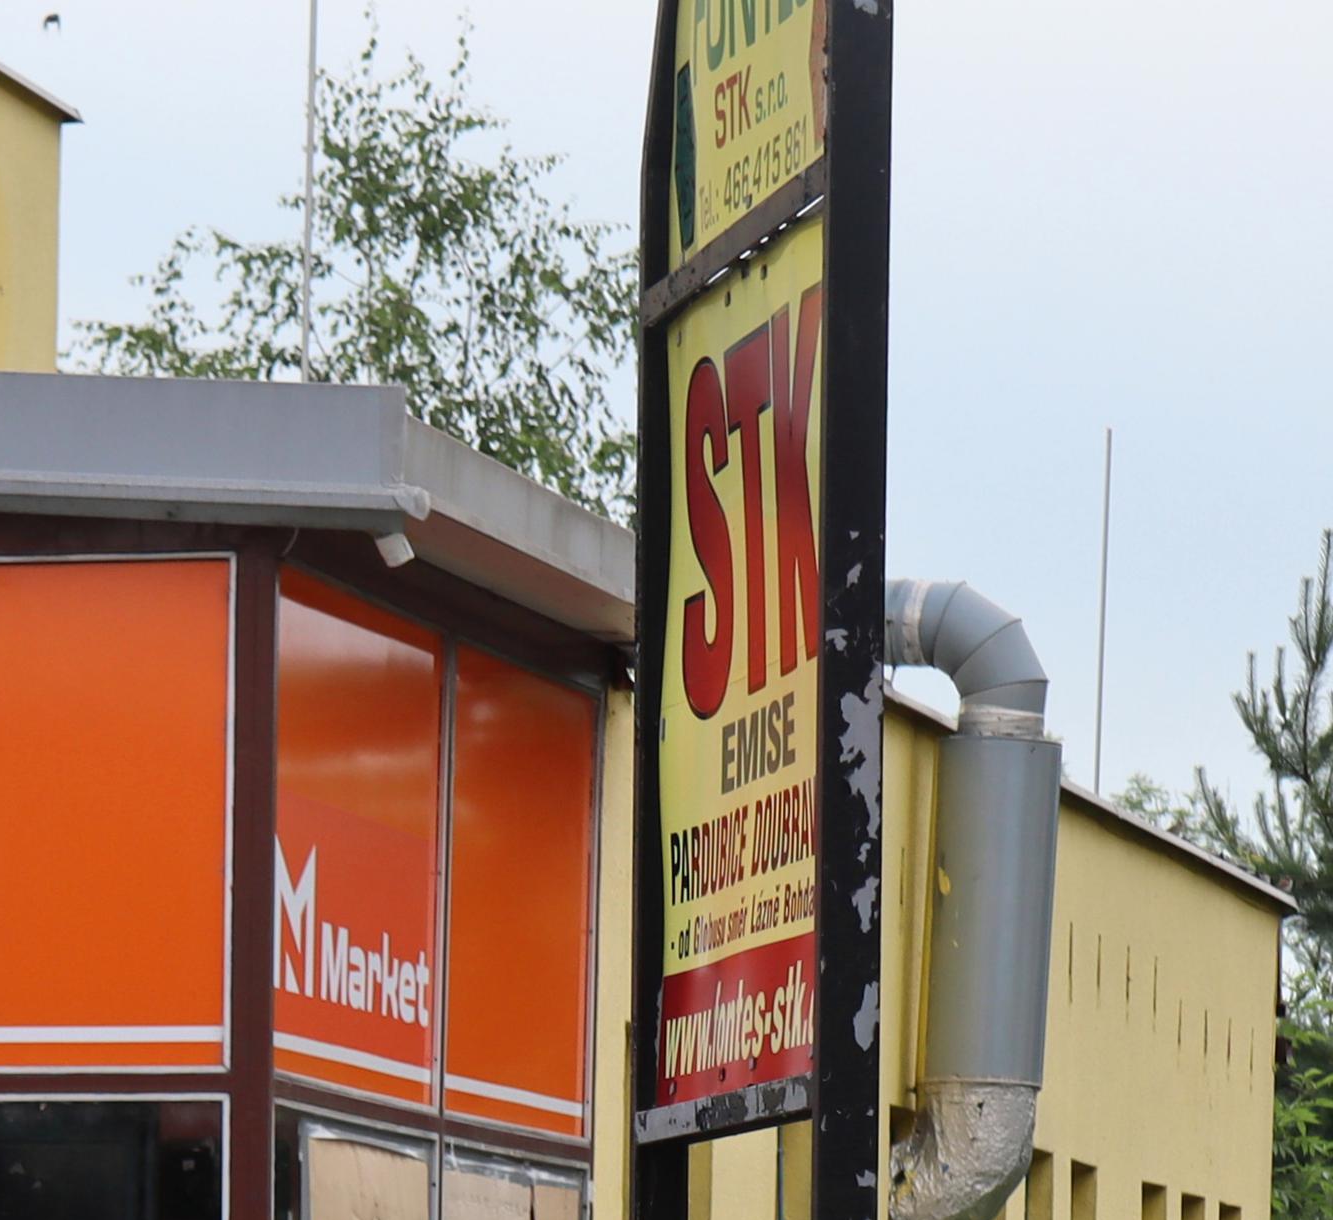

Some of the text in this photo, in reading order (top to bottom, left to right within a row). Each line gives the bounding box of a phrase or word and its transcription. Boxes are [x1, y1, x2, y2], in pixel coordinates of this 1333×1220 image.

[714, 64, 788, 149] STK s.r.o.
[752, 135, 781, 193] 415
[785, 115, 807, 176] 861
[682, 281, 823, 720] STK
[721, 690, 796, 795] EMISE
[670, 804, 749, 906] PARDUBICE
[320, 920, 430, 1028] Market
[678, 920, 691, 959] od
[750, 889, 781, 935] Lázně
